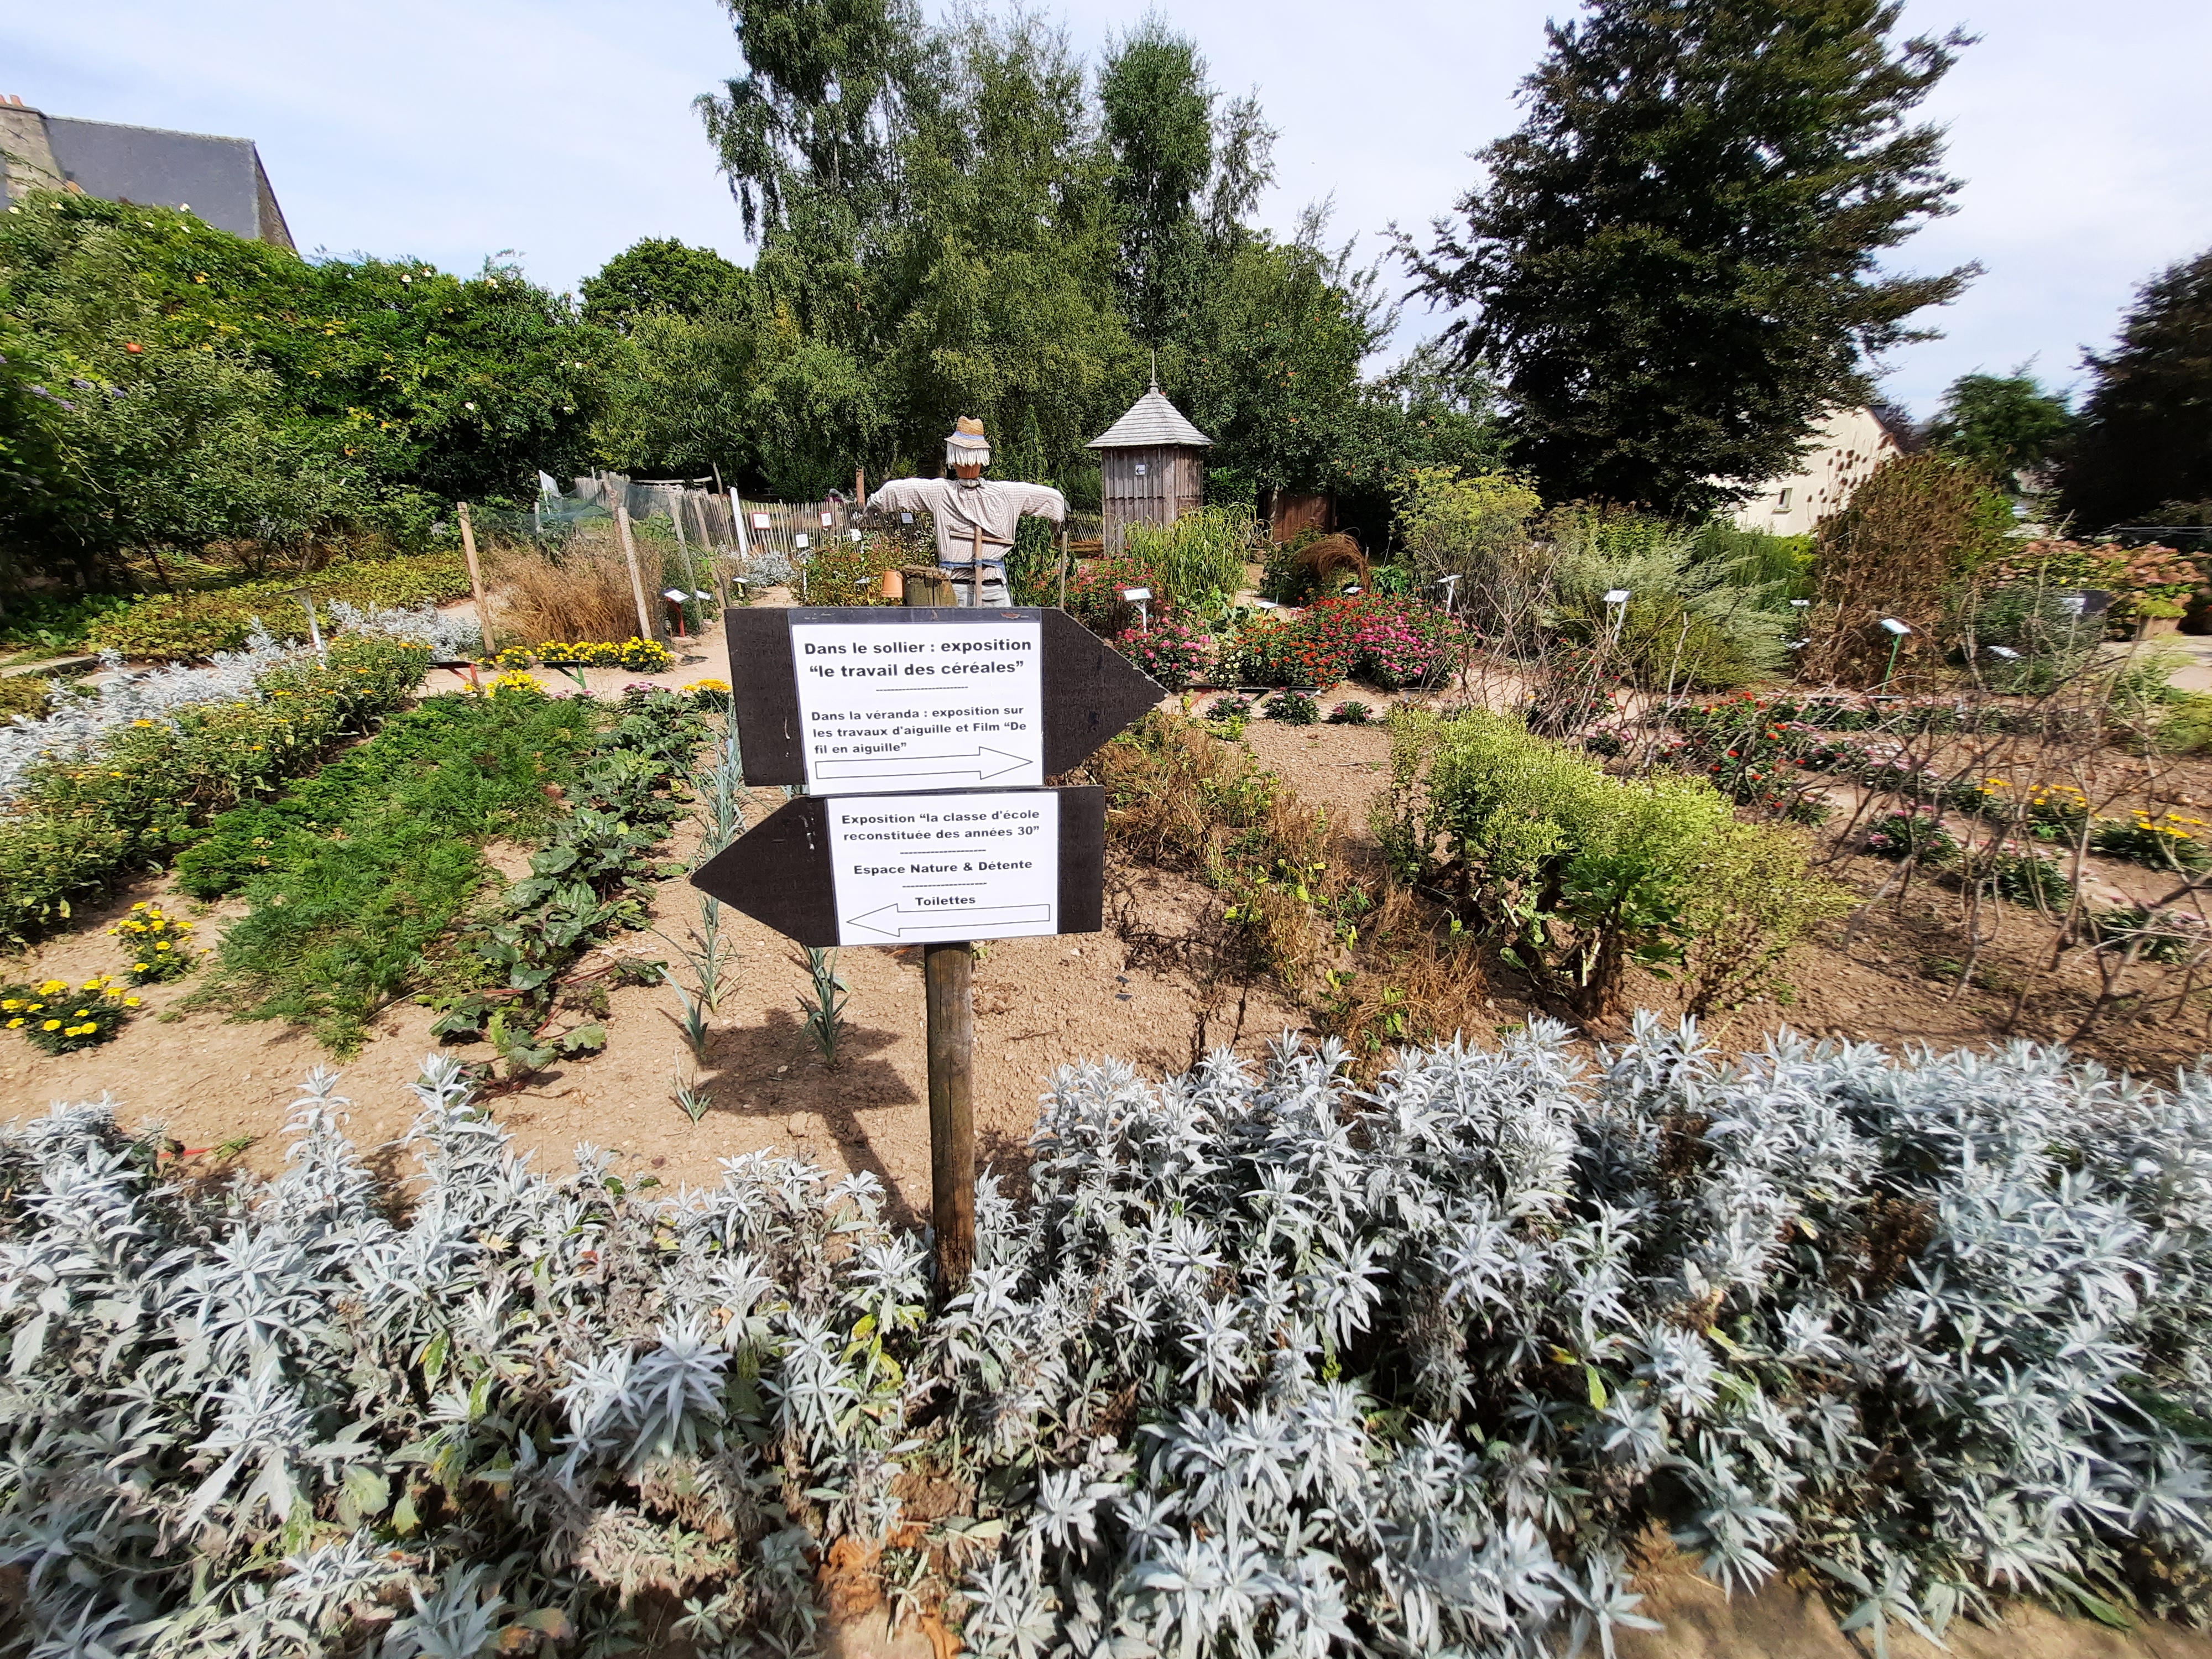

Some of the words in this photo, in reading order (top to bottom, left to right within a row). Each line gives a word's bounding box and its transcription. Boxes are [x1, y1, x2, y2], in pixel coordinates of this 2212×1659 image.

[805, 643, 846, 654] Dans
[853, 643, 867, 654] le
[874, 642, 925, 653] sollier
[941, 639, 1031, 654] exposition
[841, 664, 898, 677] travail
[905, 664, 935, 675] des
[812, 712, 844, 721] Dans
[850, 711, 861, 719] la
[866, 709, 919, 719] véranda
[932, 707, 999, 718] exposition
[813, 729, 832, 737] les
[893, 724, 951, 736] d'aiguille
[956, 724, 968, 732] et
[973, 723, 999, 731] Film
[815, 745, 827, 754] fil
[842, 814, 915, 826] Exposition
[943, 813, 987, 821] classe
[992, 810, 1039, 820] d'école
[844, 831, 931, 841] reconstituée
[936, 830, 959, 838] des
[965, 828, 1013, 837] années
[854, 865, 905, 876] Espace
[911, 864, 957, 873] Nature
[963, 863, 973, 871] &
[979, 860, 1032, 870] Détente
[915, 896, 975, 906] Toilettes
